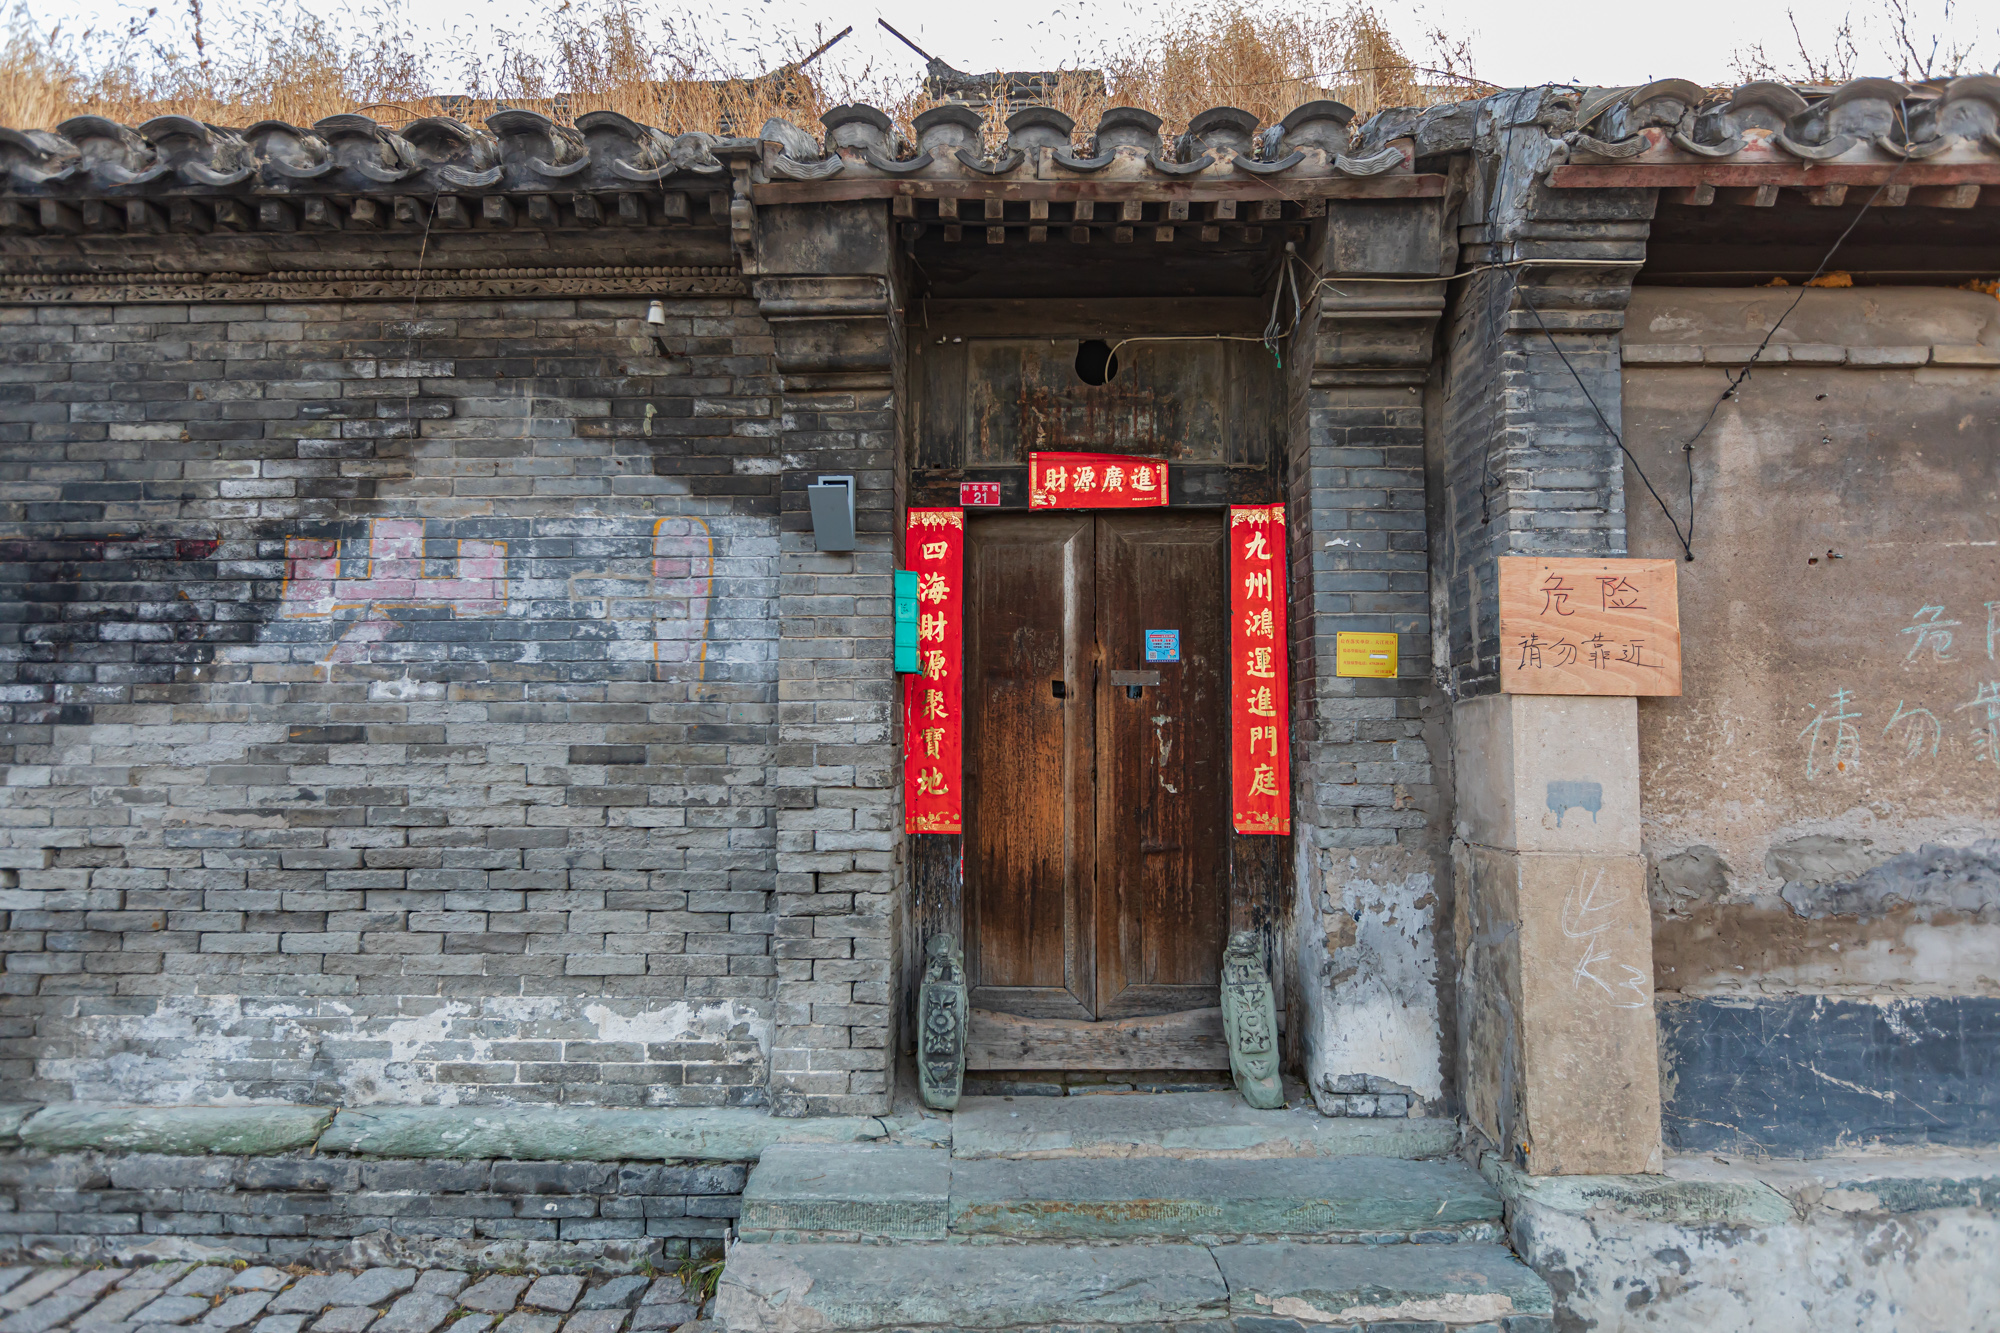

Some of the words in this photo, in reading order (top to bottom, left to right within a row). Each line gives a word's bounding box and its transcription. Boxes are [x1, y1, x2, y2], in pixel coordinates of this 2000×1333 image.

[973, 492, 987, 504] 21
[1043, 465, 1158, 493] 財源廣進
[1539, 572, 1647, 616] 危险
[916, 540, 950, 796] 四海財源聚寶地
[1244, 530, 1280, 797] 九州鴻運進門庭
[1517, 631, 1665, 670] 请勿靠近
